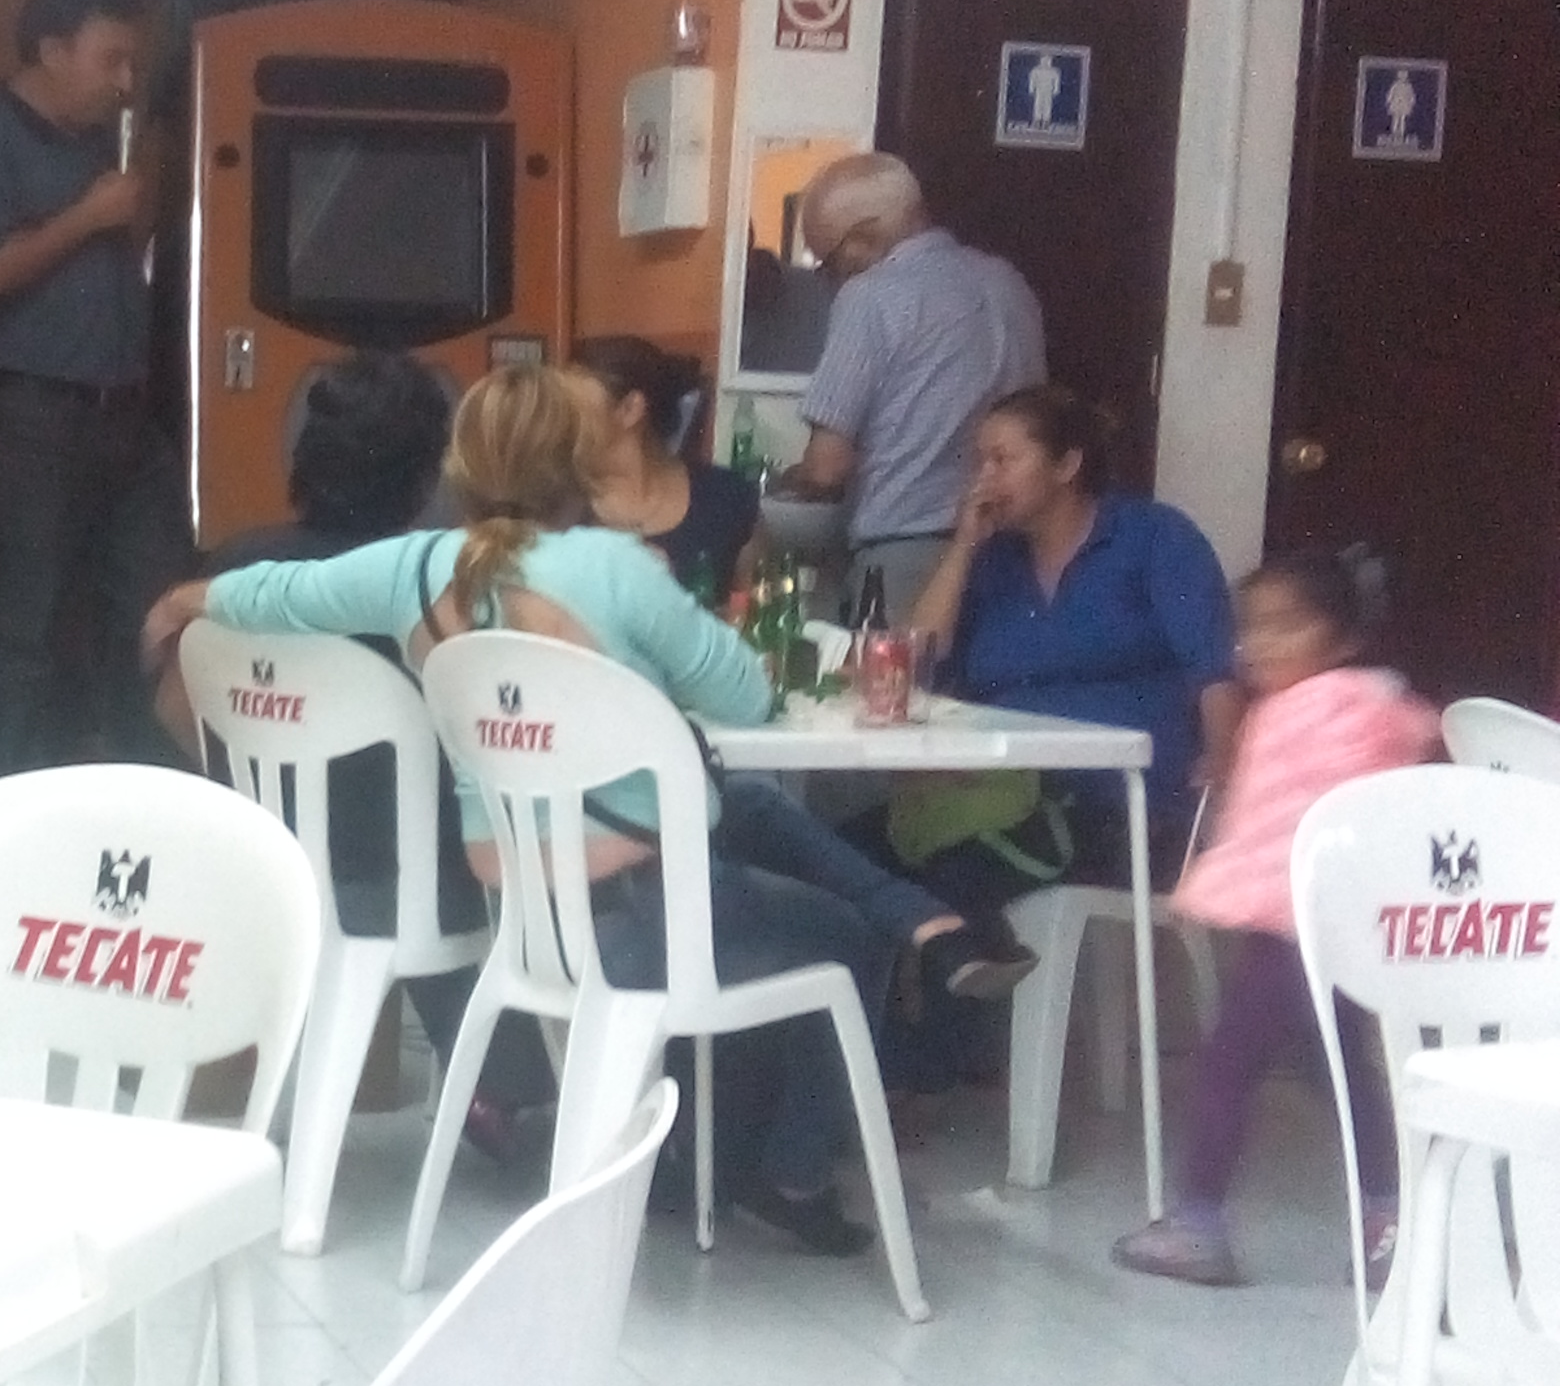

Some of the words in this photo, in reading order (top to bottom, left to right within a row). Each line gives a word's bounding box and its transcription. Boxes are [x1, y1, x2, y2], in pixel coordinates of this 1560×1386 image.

[227, 687, 306, 723] TECATE
[476, 719, 555, 751] TECATE
[1376, 897, 1555, 960] TECATE
[8, 915, 205, 1004] TECATE
